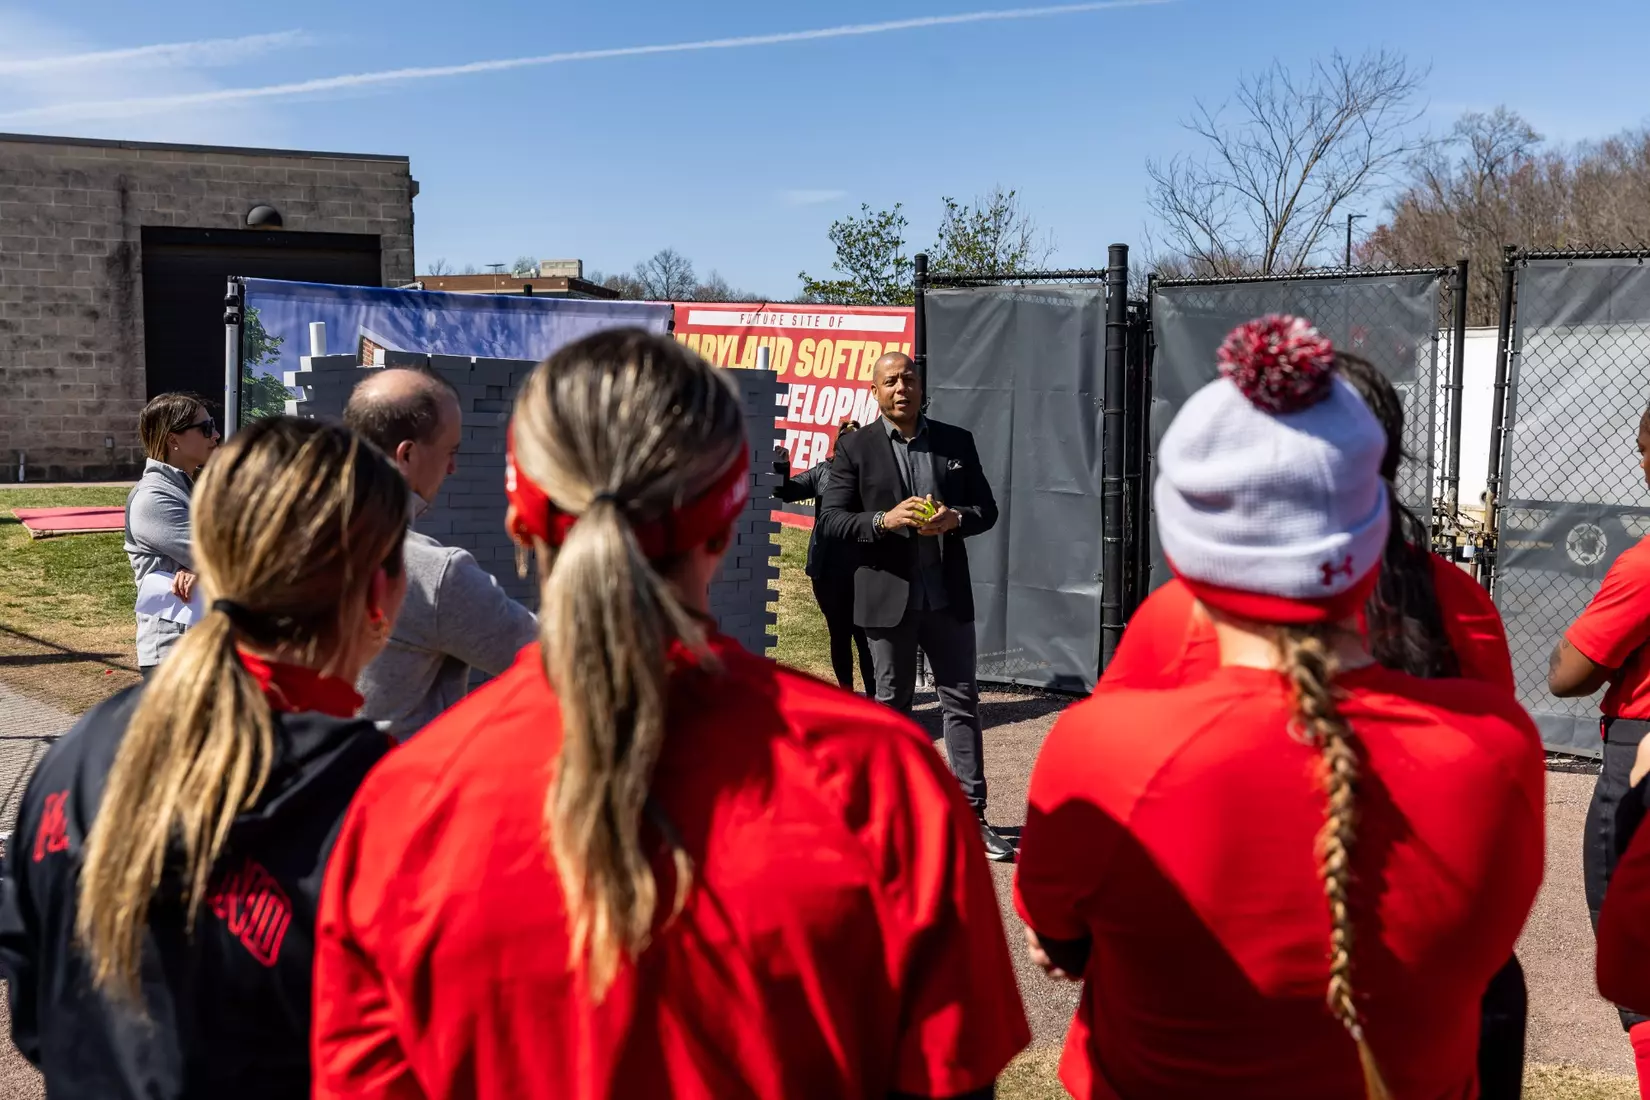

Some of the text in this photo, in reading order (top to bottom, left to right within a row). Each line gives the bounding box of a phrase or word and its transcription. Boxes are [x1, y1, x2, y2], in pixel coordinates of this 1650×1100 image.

[740, 313, 844, 328] FUTURE SITE OF
[794, 337, 911, 381] SOFTB
